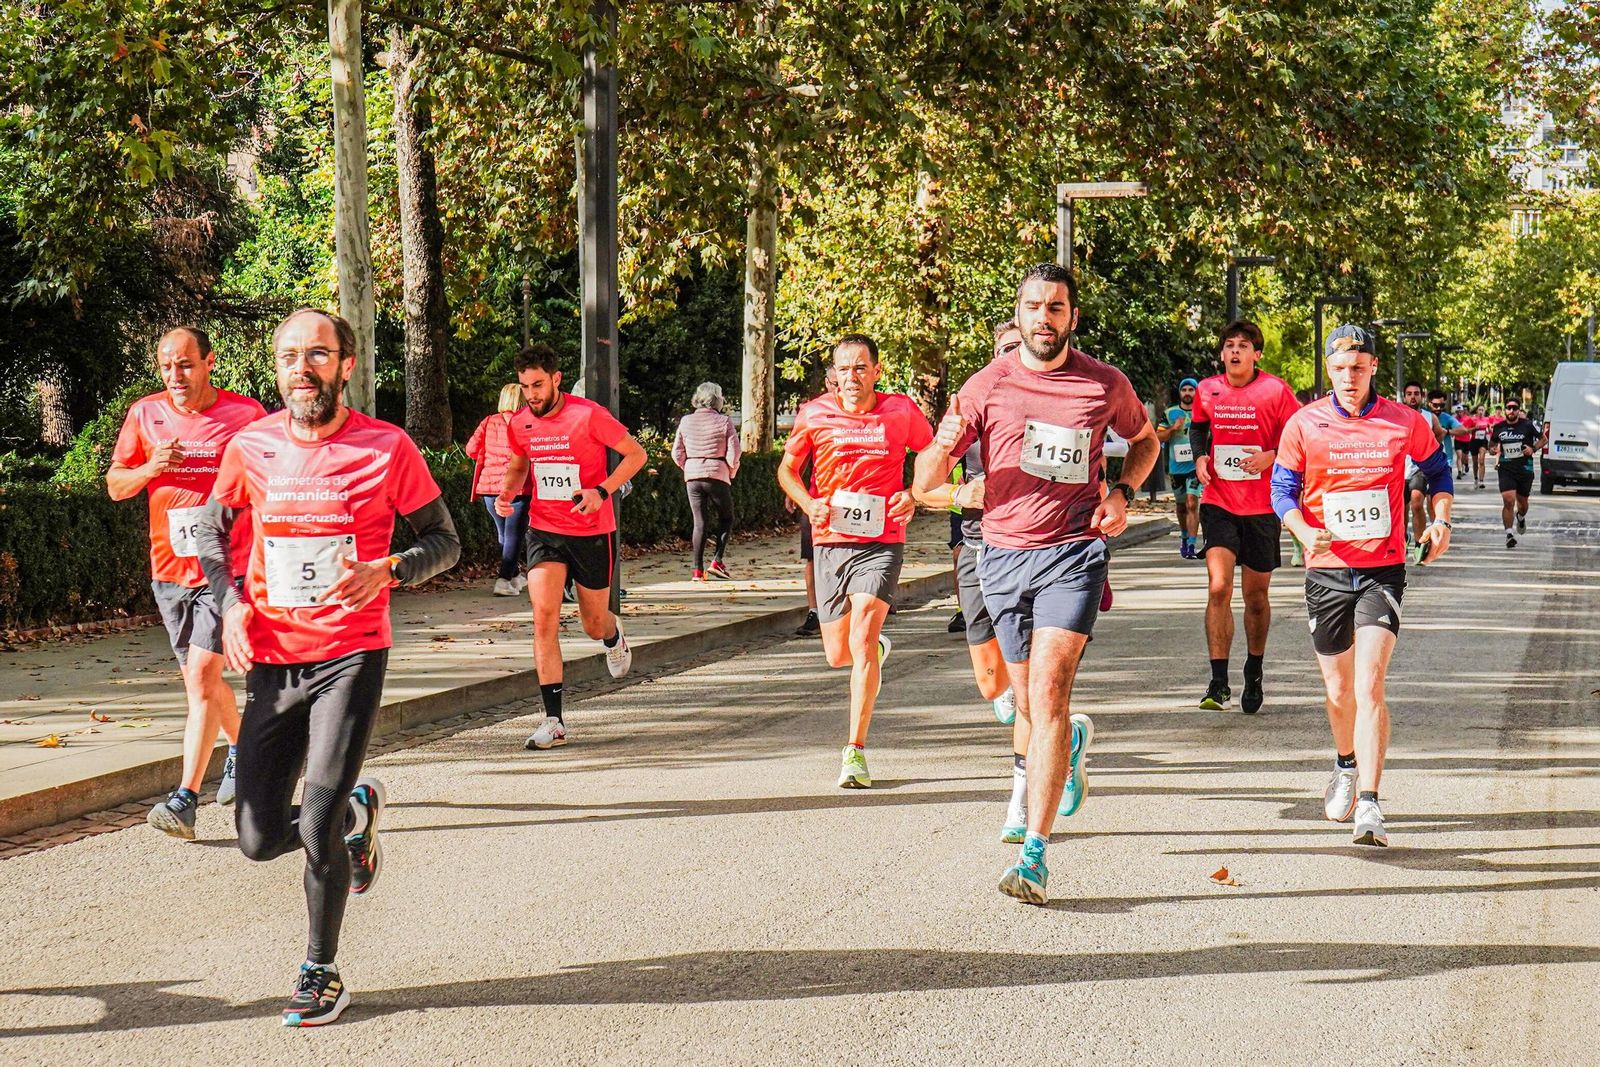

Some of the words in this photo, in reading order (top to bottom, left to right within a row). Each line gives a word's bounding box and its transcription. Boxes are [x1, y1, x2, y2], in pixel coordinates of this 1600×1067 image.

[833, 435, 884, 445] humanidad
[1377, 440, 1389, 448] de
[530, 442, 570, 451] humanidad
[1034, 443, 1083, 464] 1150
[1329, 450, 1389, 460] humanidad
[1327, 467, 1393, 475] #CarreraCruzRoja
[268, 475, 330, 487] kilómetros
[333, 475, 348, 486] de
[541, 476, 571, 487] 1791
[266, 489, 349, 502] humanidad
[843, 507, 871, 522] 791
[1334, 507, 1380, 523] 1319
[302, 562, 316, 581] 5
